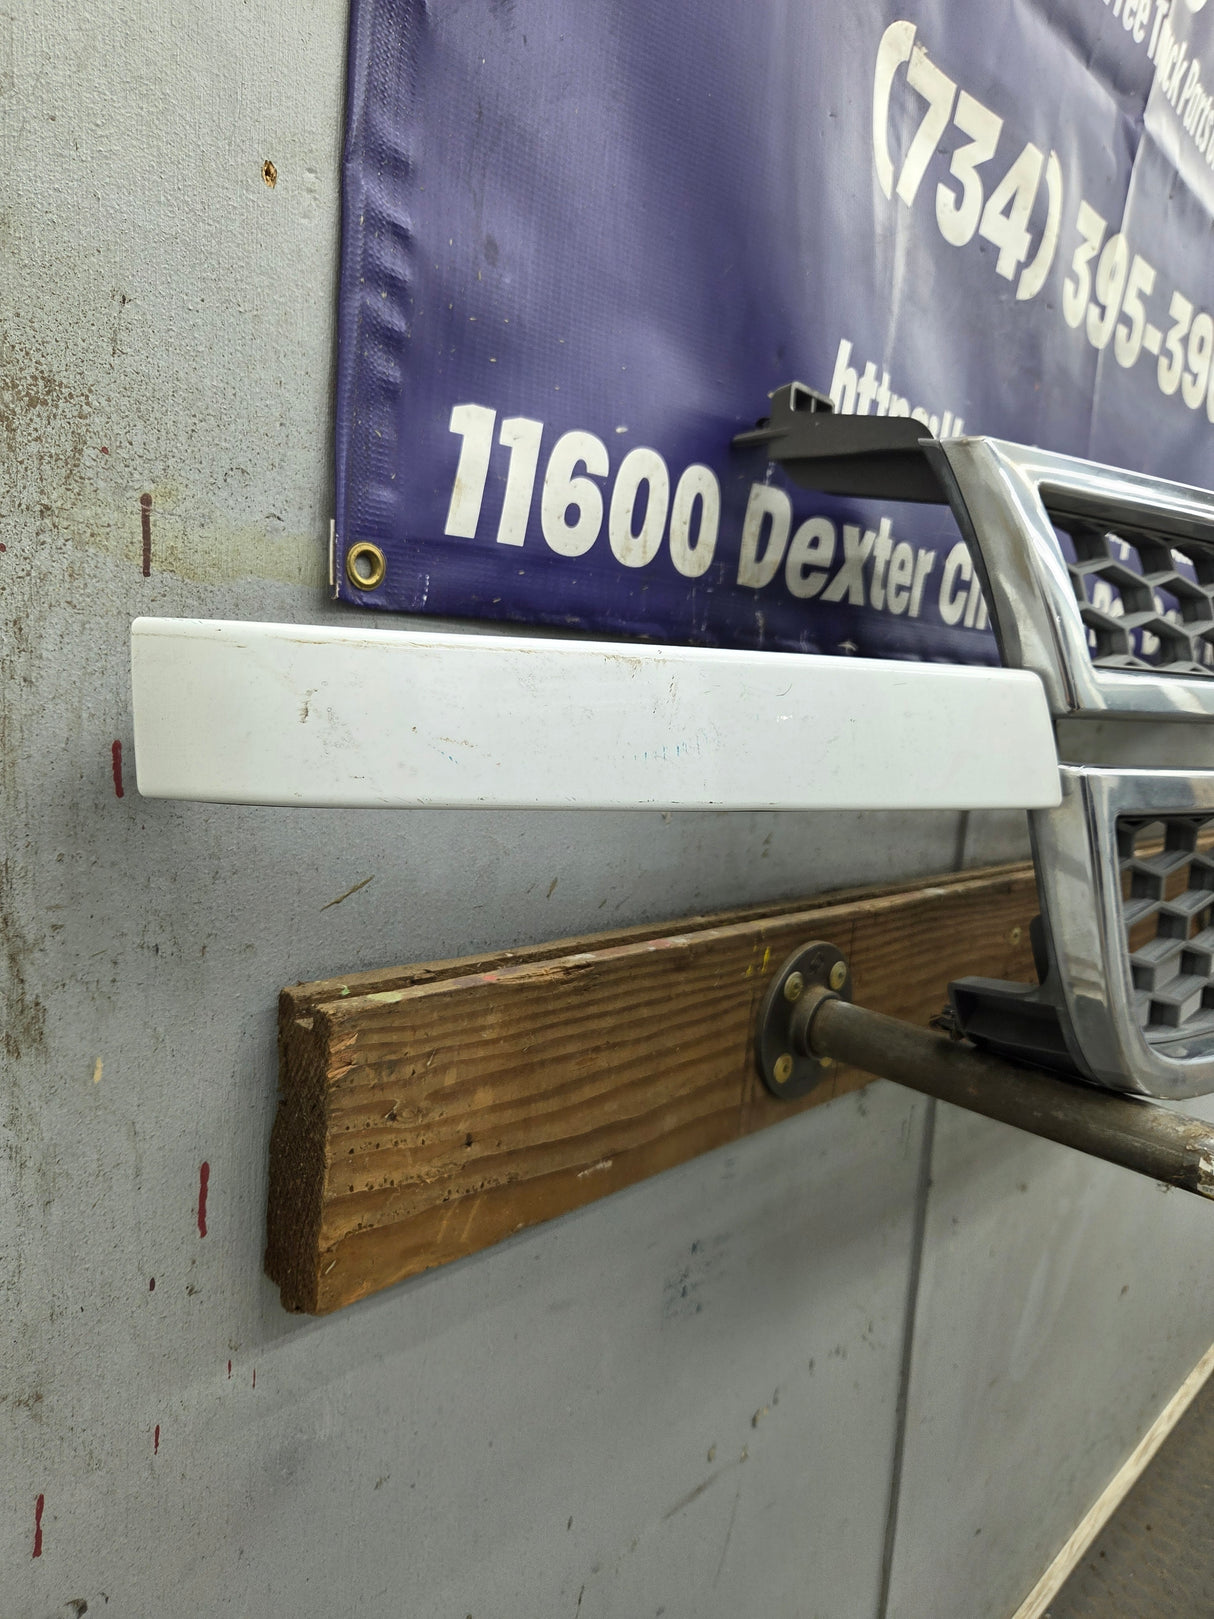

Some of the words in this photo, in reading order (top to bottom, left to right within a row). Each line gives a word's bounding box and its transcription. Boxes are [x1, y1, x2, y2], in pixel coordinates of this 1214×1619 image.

[873, 20, 1063, 300] (734)
[1063, 199, 1214, 424] 395-39
[444, 404, 721, 578] 11600
[737, 482, 935, 618] Dexter
